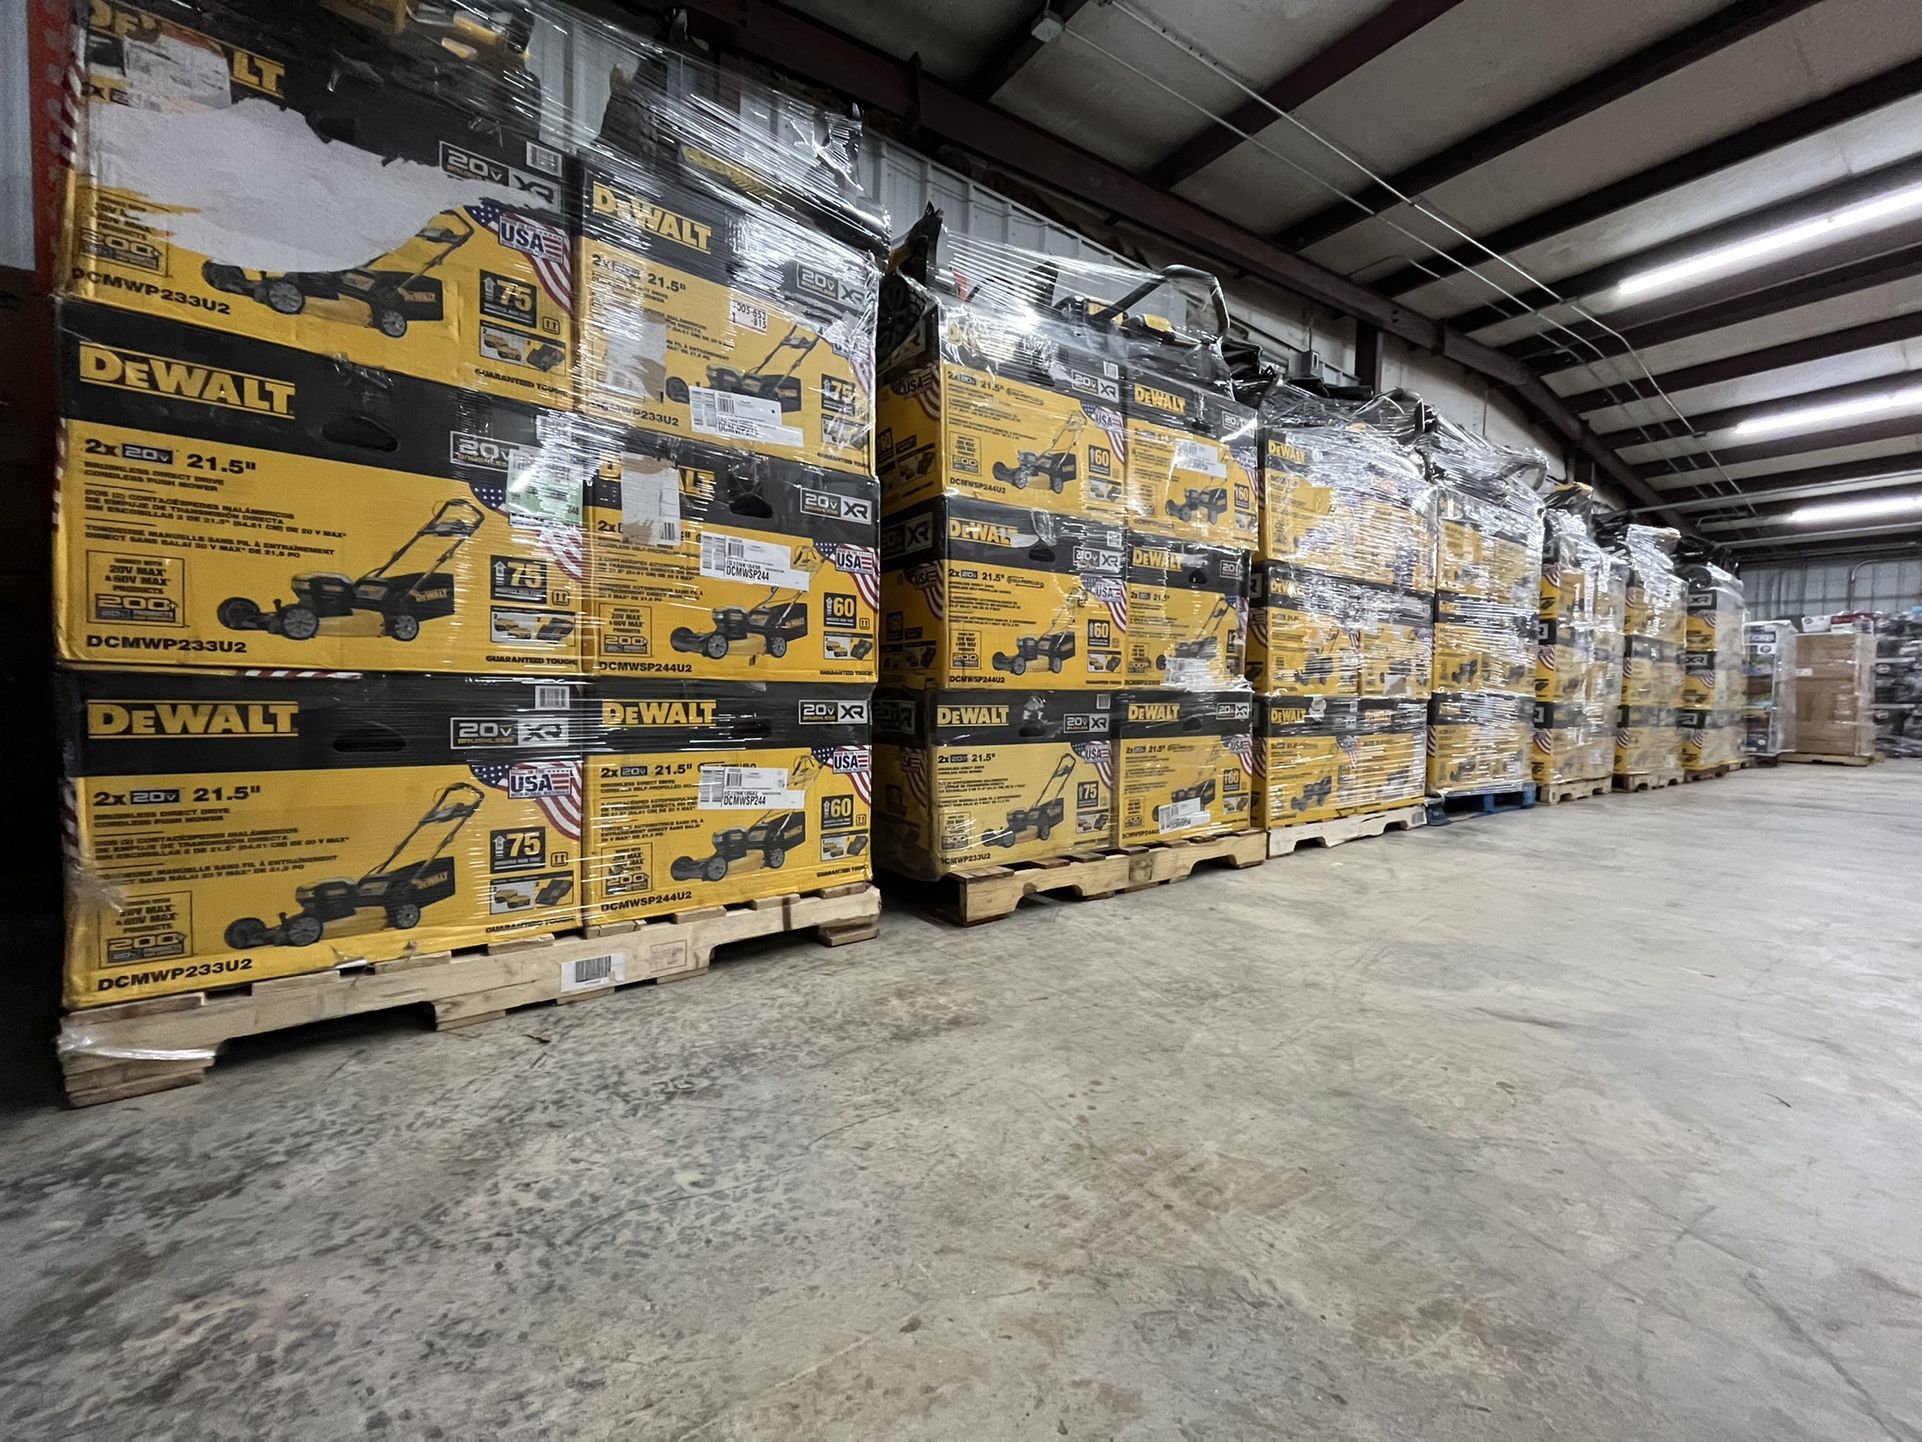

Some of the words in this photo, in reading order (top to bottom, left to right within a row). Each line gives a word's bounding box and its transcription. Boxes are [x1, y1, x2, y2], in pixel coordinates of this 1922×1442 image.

[501, 222, 546, 253] USA
[72, 268, 231, 316] DCMWP233U2
[496, 280, 532, 310] 75
[80, 344, 295, 415] DEWALT
[187, 453, 256, 474] 21.5"
[843, 501, 868, 519] XR
[837, 553, 861, 569] USA
[1101, 554, 1119, 567] XR
[726, 565, 770, 581] DCMWSP244
[1096, 586, 1113, 598] USA
[833, 597, 855, 617] 60
[1094, 623, 1108, 638] 60
[87, 634, 246, 653] DCMWP233U2
[599, 661, 692, 673] DCMWSP244U2
[88, 704, 298, 735] DEWALT
[601, 702, 717, 725] DEWALT
[840, 705, 864, 719] XR
[937, 706, 1009, 725] DEWALT
[1128, 704, 1180, 721] DEWALT
[1091, 718, 1107, 729] XR
[834, 755, 858, 769] USA
[1085, 748, 1101, 760] USA
[655, 764, 692, 776] 21.5"
[511, 774, 552, 792] USA
[1084, 785, 1097, 799] 75
[193, 785, 260, 802] 21.5"
[724, 796, 766, 806] DCMWSP244
[831, 798, 852, 818] 60
[506, 832, 541, 857] 75
[601, 891, 692, 912] DCMWSP244U2
[97, 958, 253, 992] DCMWP233U2
